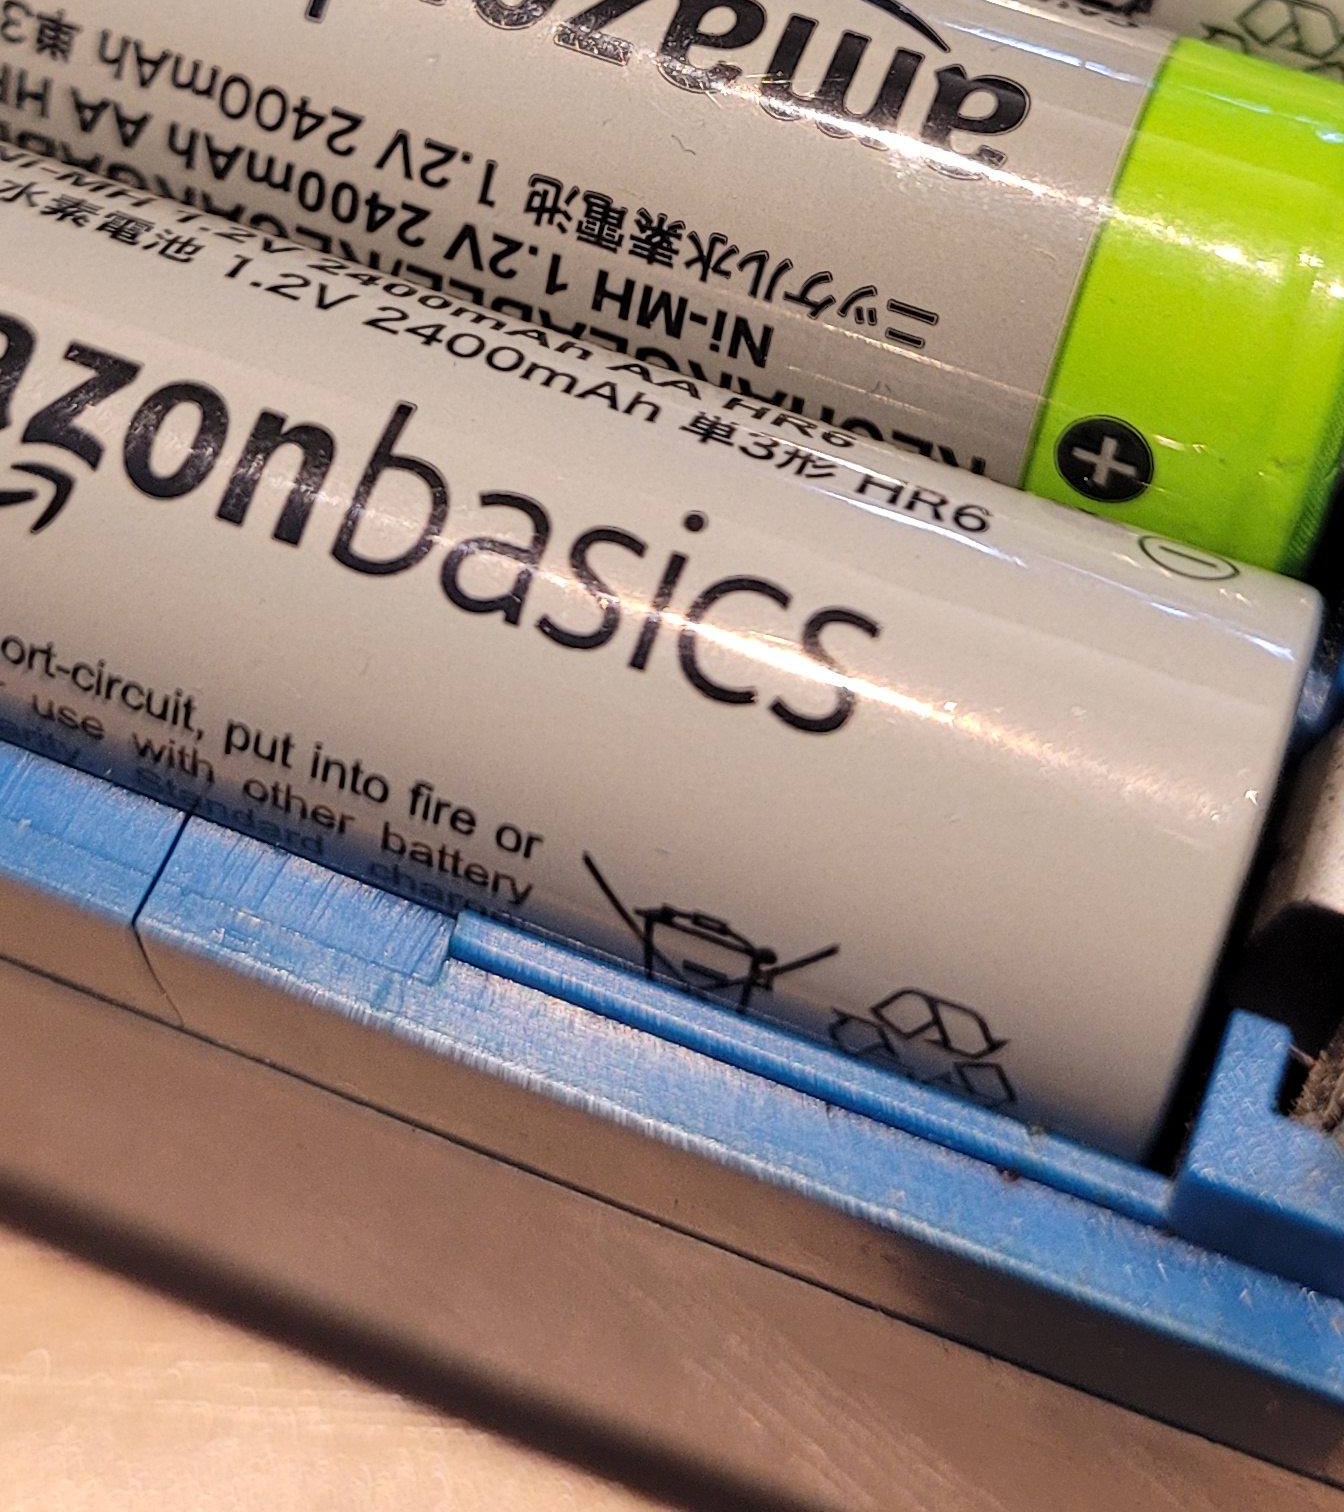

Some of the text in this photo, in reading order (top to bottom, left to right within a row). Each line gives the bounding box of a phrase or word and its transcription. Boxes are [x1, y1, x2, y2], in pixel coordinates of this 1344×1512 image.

[69, 87, 152, 150] AA
[98, 28, 365, 157] 2400mAh
[167, 122, 431, 249] 2400mAh
[376, 129, 498, 208] 1.2V
[444, 223, 570, 296] 1.2V
[524, 174, 940, 349] ニッケル水素電池
[591, 270, 774, 368] Ni-MH
[175, 209, 306, 257] 1.2V
[307, 258, 594, 361] 2400mAh
[606, 362, 703, 401] AA
[723, 396, 855, 449] HR6
[224, 254, 360, 311] 1.2V
[362, 306, 663, 423] 2400mAh
[678, 410, 838, 480] 単3形
[856, 473, 995, 536] HR6
[31, 692, 104, 740] use
[131, 731, 217, 785] with
[242, 777, 356, 835] other
[380, 820, 535, 907] battery
[224, 719, 296, 769] put
[310, 741, 390, 805] into
[409, 779, 476, 838] fire
[495, 823, 545, 860] or
